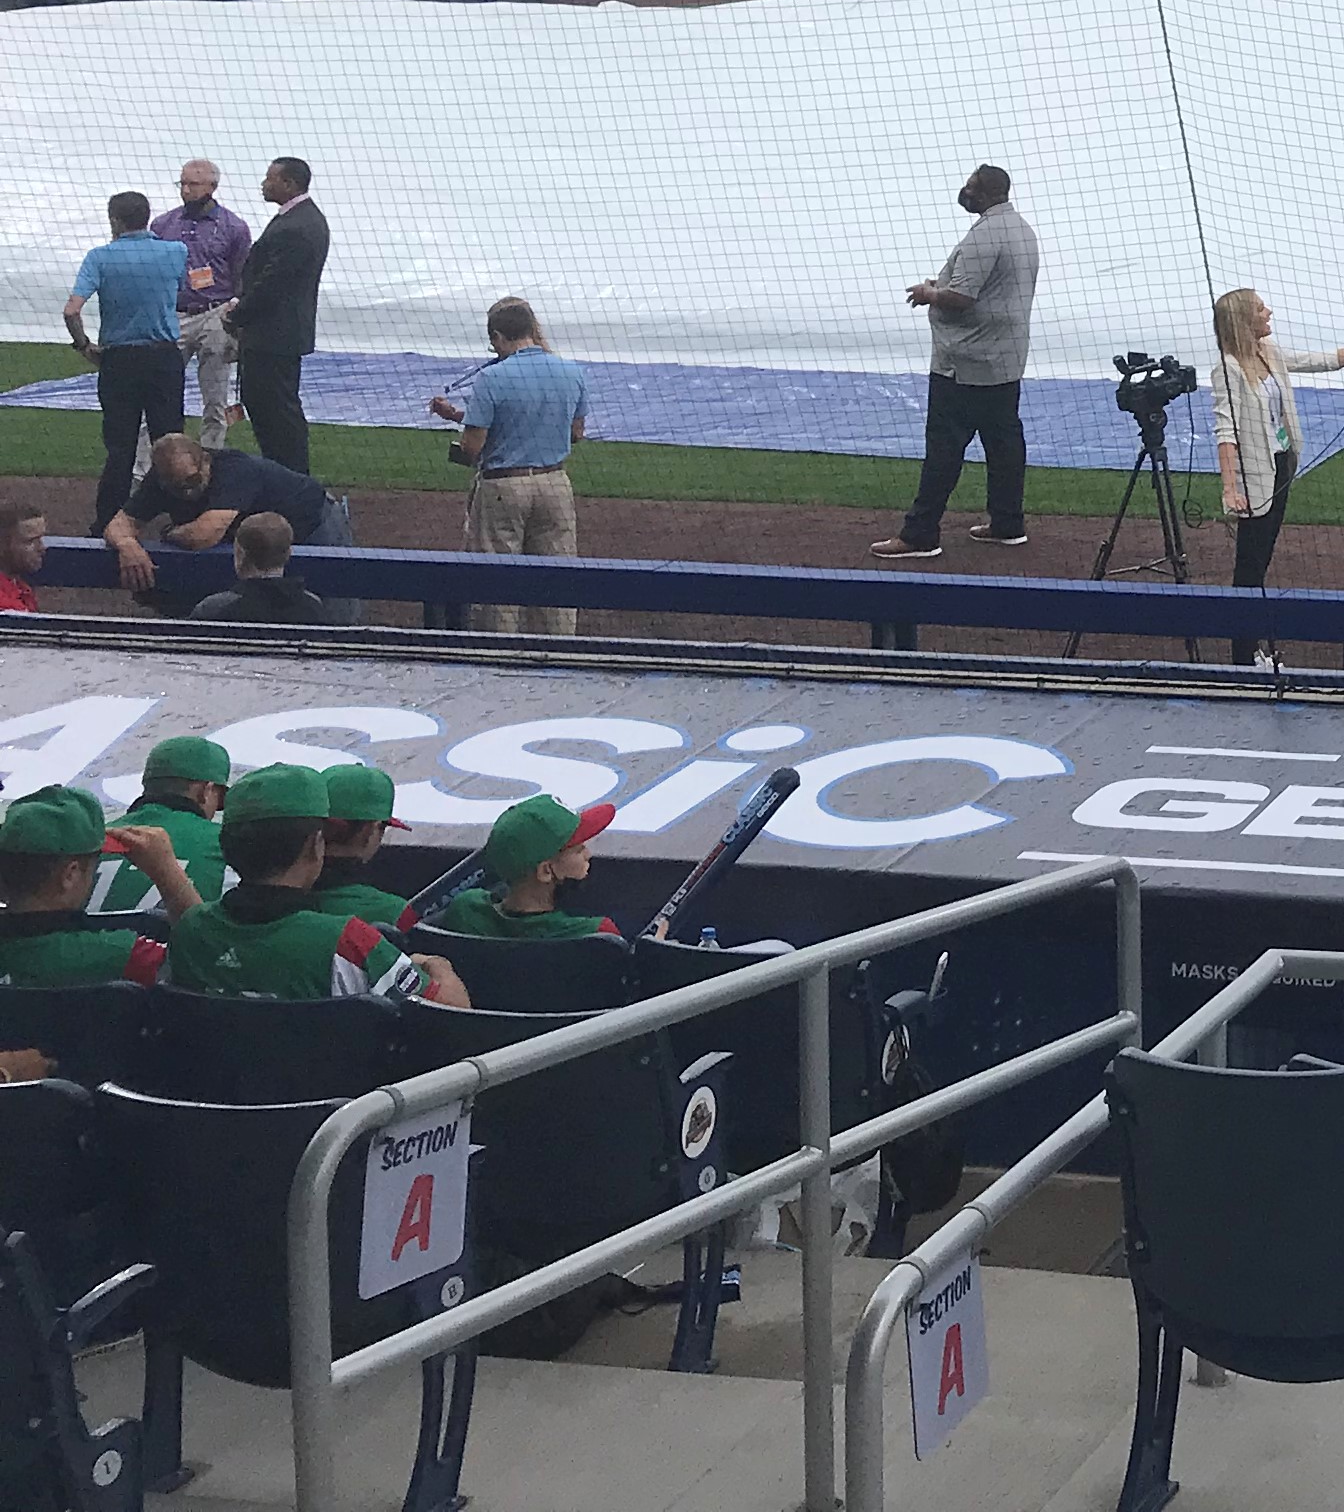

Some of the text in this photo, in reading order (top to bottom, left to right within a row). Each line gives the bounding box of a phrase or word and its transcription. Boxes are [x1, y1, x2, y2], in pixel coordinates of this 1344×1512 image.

[1171, 961, 1239, 981] MASKS
[380, 1121, 458, 1172] SECTION
[390, 1174, 434, 1262] A
[919, 1265, 972, 1335] SECTION
[938, 1322, 965, 1416] A
